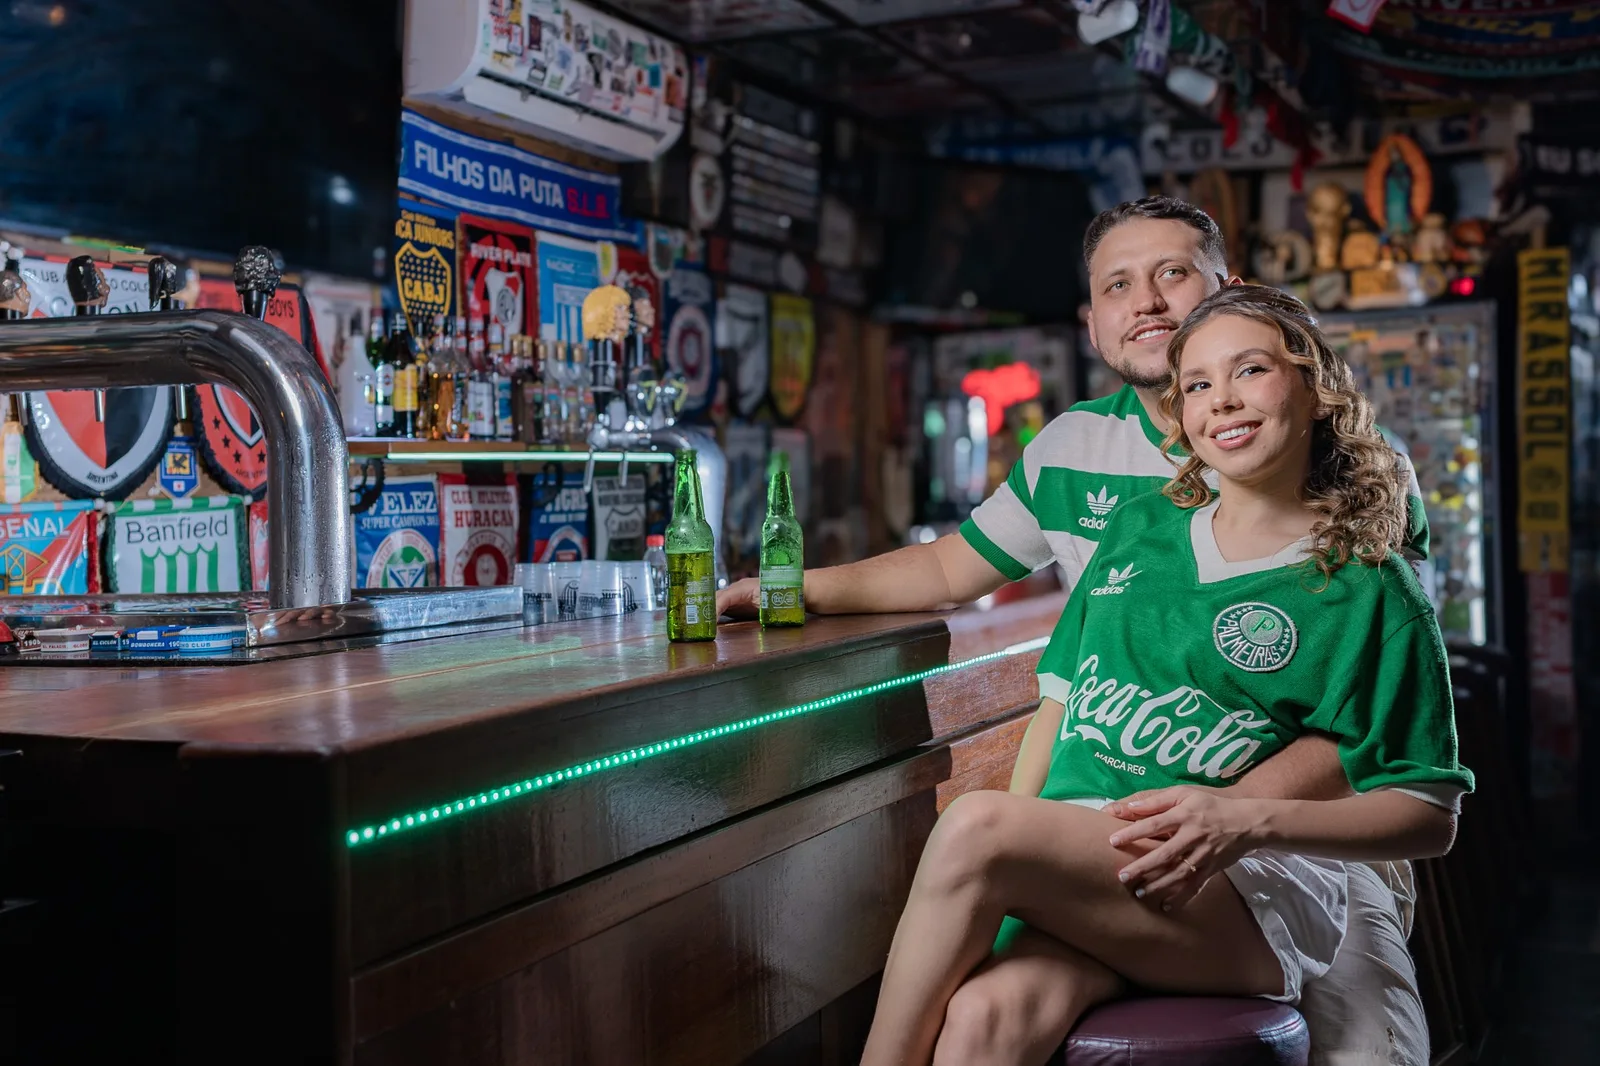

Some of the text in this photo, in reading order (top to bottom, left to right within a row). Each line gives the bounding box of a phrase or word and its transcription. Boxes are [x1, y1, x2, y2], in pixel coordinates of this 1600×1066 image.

[414, 139, 484, 190] FILHOS
[489, 165, 516, 196] DA
[519, 174, 565, 209] PUTA
[414, 223, 455, 250] JUNIORS
[470, 242, 532, 268] RIVER PLATE
[404, 278, 445, 304] CABJ
[268, 299, 295, 318] BOYS
[1525, 257, 1565, 462] MIRASSOL
[86, 471, 119, 484] ARGENTINA
[451, 490, 473, 505] CLUB
[126, 514, 228, 544] Banfield
[361, 516, 390, 530] SUPER
[454, 509, 514, 528] HURACAN
[1078, 516, 1108, 530] adid
[1090, 584, 1126, 596] adidas
[1250, 615, 1276, 634] P
[1217, 616, 1281, 667] PALMEIRAS
[1060, 654, 1272, 779] Coca-Cola
[1094, 751, 1147, 776] MARCA REG
